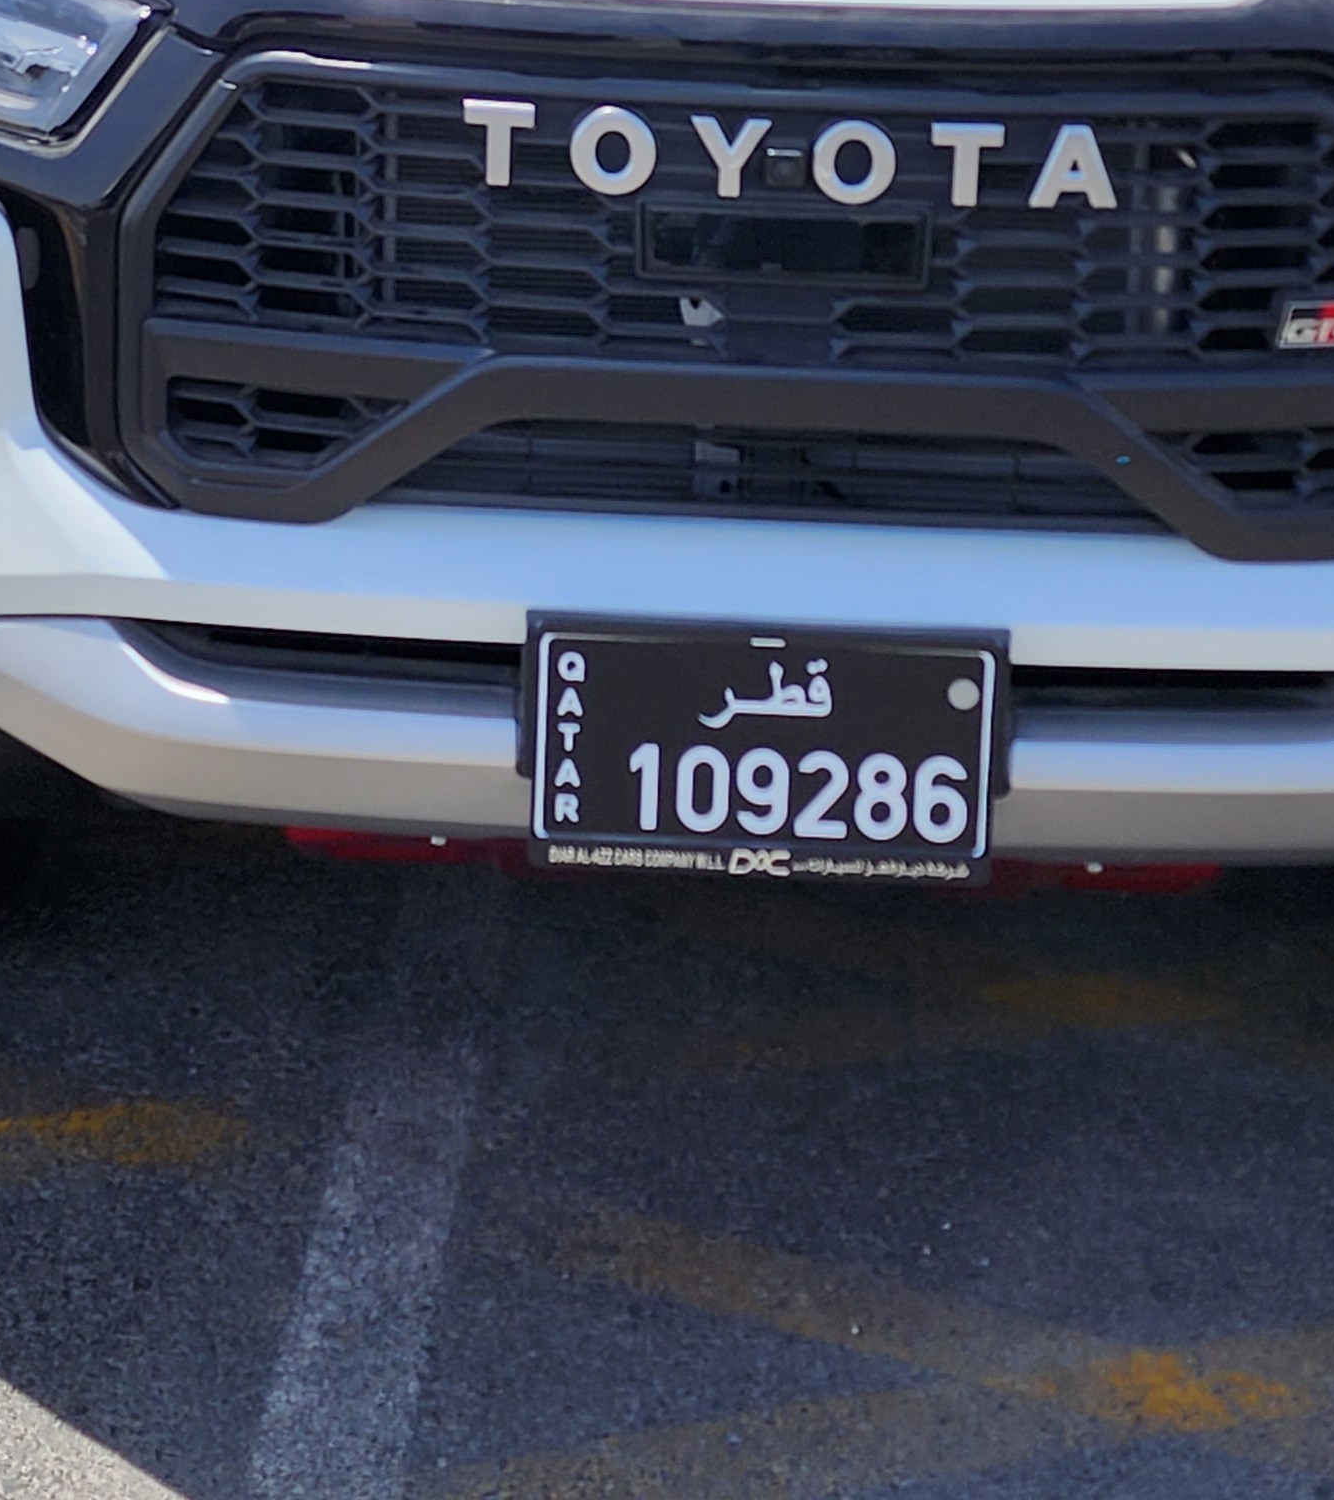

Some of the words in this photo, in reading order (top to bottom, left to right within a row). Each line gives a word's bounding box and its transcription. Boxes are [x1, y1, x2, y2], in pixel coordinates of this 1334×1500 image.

[463, 98, 1118, 210] TOYOTA
[554, 650, 587, 824] QATAR
[698, 658, 833, 729] قطر
[628, 742, 968, 844] 109286
